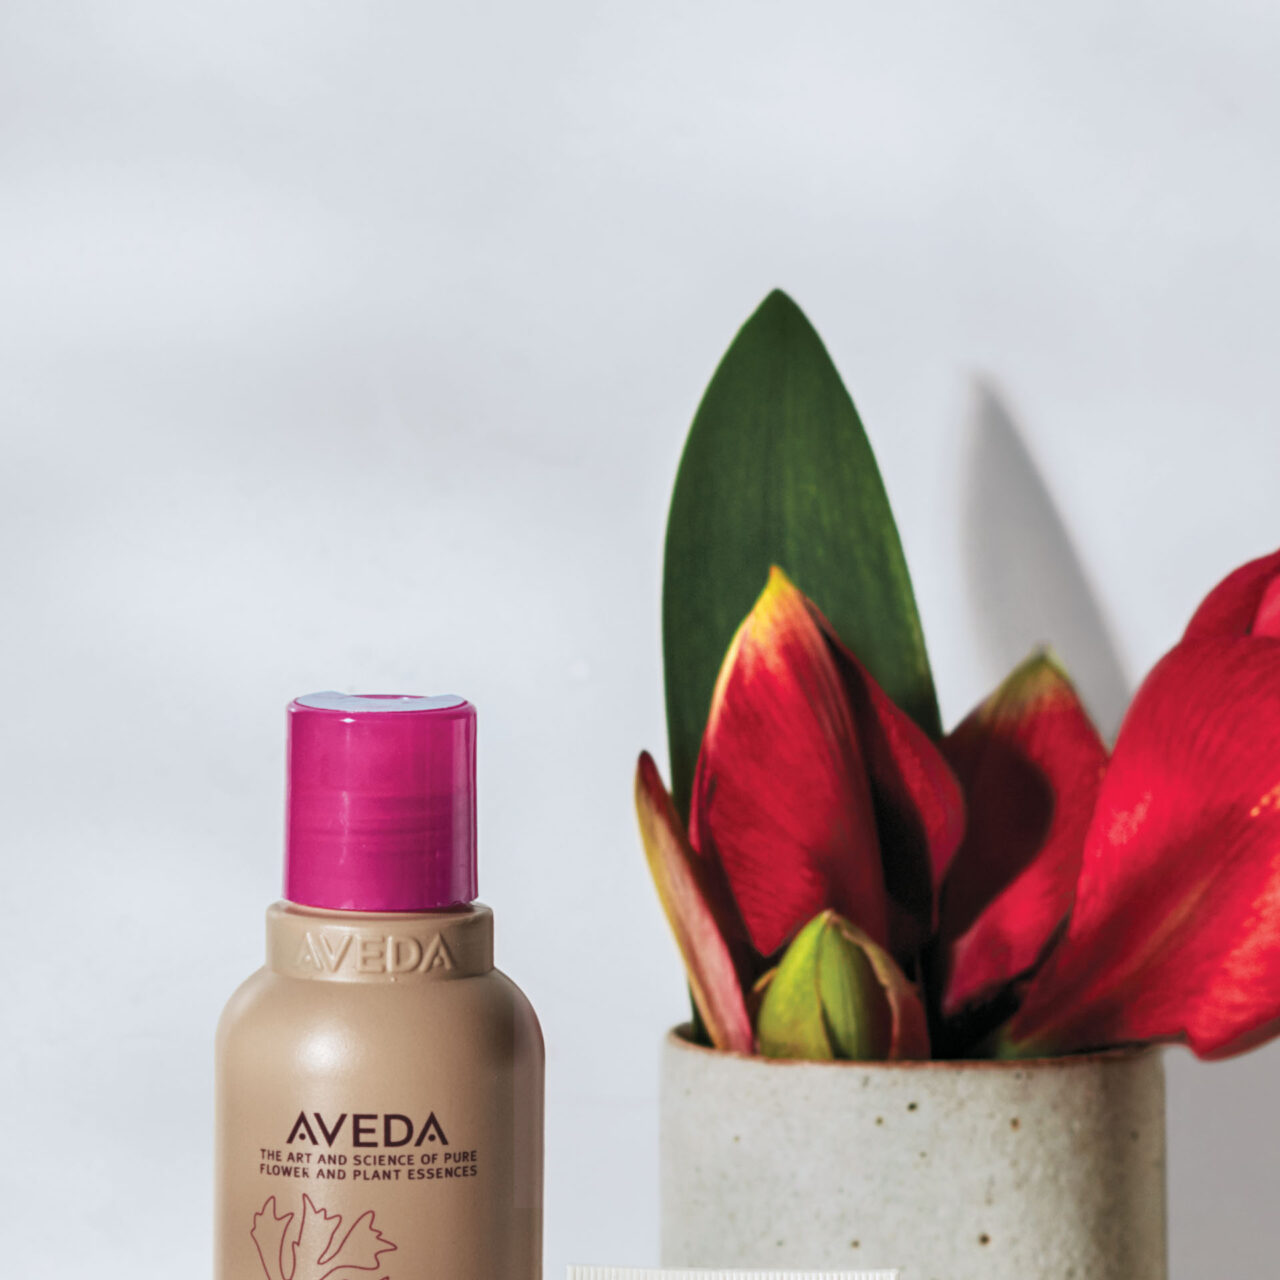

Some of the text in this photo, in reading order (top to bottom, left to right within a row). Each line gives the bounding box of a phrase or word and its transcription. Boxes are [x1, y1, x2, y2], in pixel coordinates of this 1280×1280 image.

[301, 931, 457, 974] AVEDA
[286, 1110, 449, 1148] AVEDA
[260, 1149, 477, 1166] THE ART AND SCIENCE OF PURE
[260, 1163, 477, 1180] FLOWER AND PLANT ESSENCES
